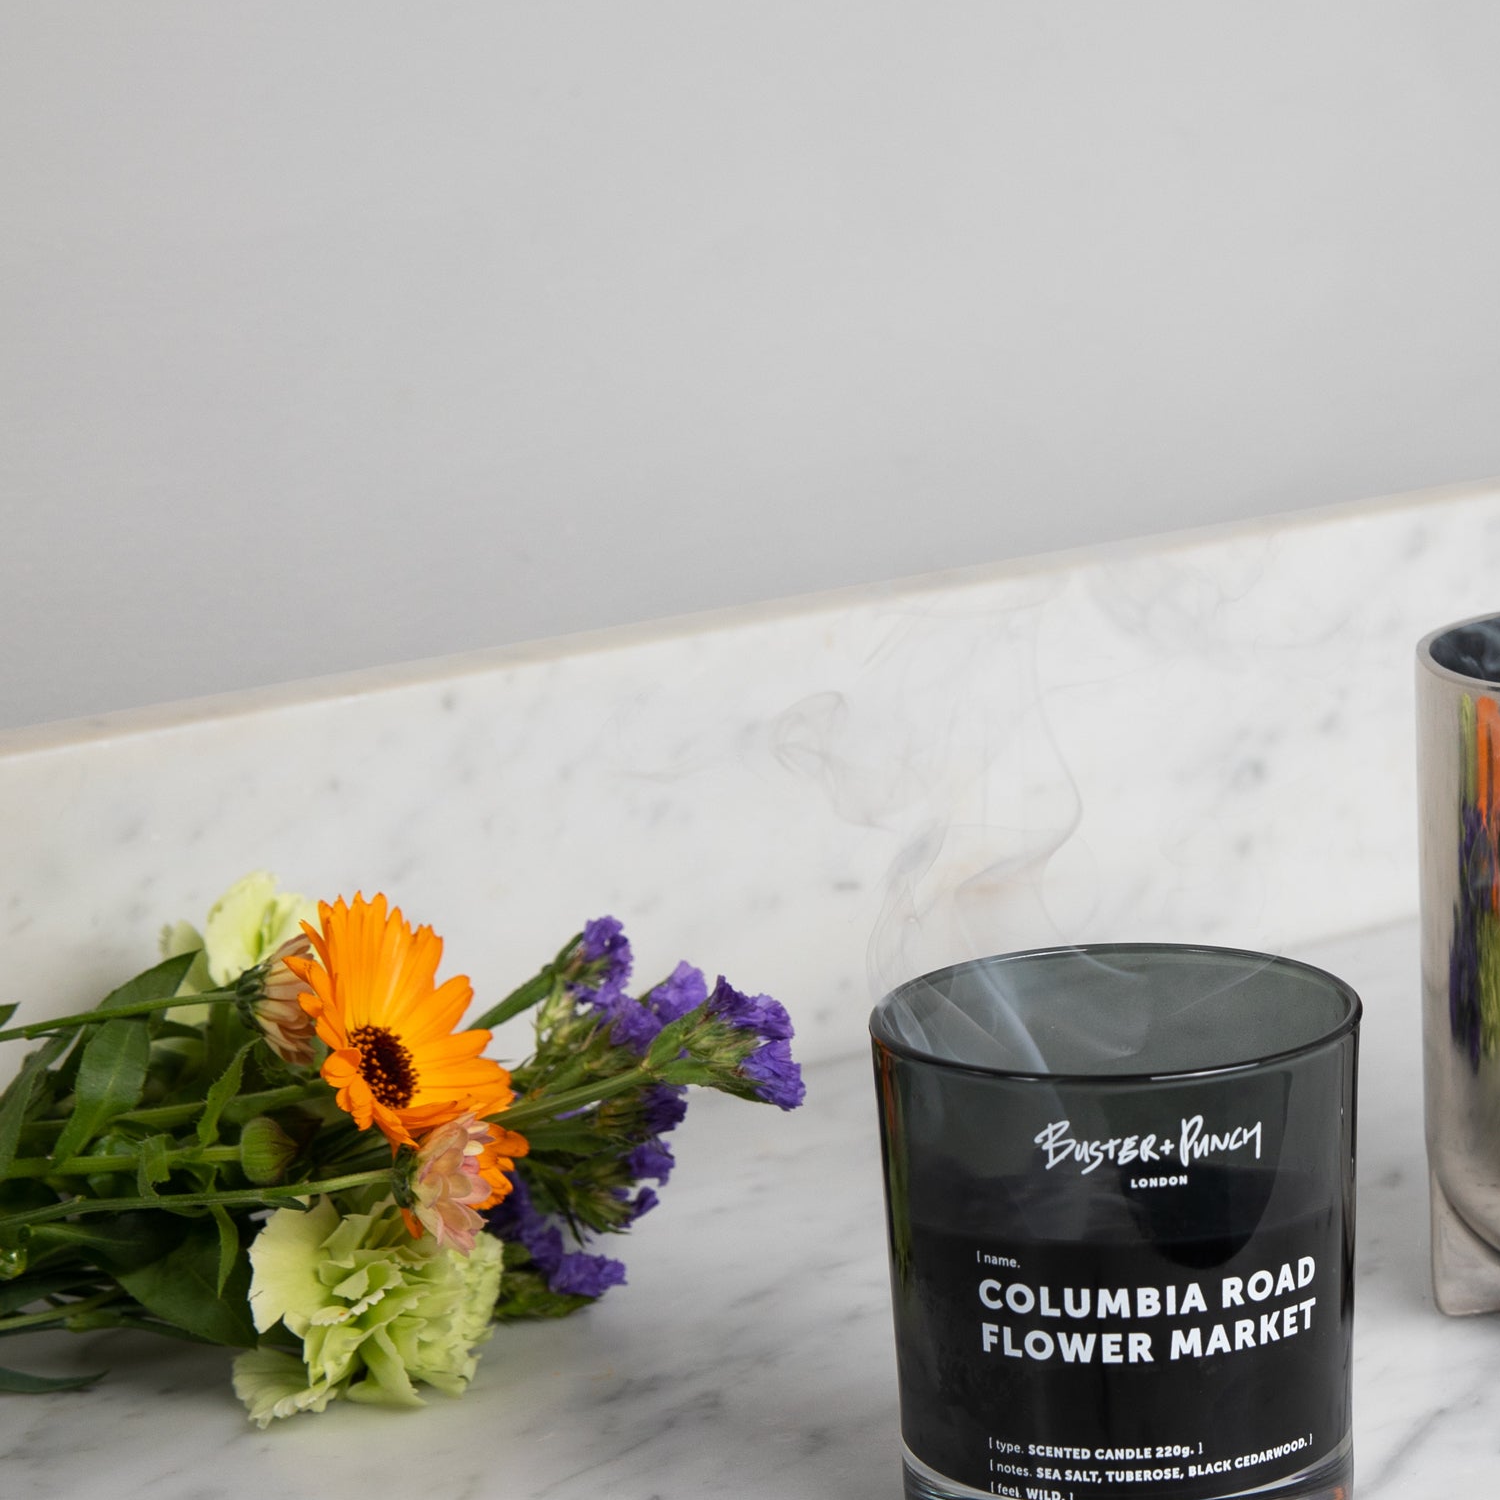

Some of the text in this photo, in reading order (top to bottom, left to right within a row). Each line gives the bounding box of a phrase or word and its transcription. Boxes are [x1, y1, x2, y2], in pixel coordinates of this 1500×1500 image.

[1130, 1174, 1188, 1189] LONDON
[984, 1253, 1021, 1269] name.
[978, 1255, 1316, 1319] COLUMBIA ROAD
[981, 1297, 1317, 1364] FLOWER MARKET
[996, 1439, 1024, 1454] type.
[1028, 1444, 1090, 1460] SCENTED
[1095, 1447, 1152, 1460] CANDLE
[1155, 1445, 1195, 1458] 220g.
[997, 1462, 1032, 1477] notes.
[1036, 1467, 1062, 1481] SEA
[1065, 1469, 1102, 1484] SALT,
[1105, 1467, 1184, 1483] TUBEROSE,
[1188, 1459, 1232, 1477] BLACK
[1234, 1437, 1308, 1468] CEDARWOOD.
